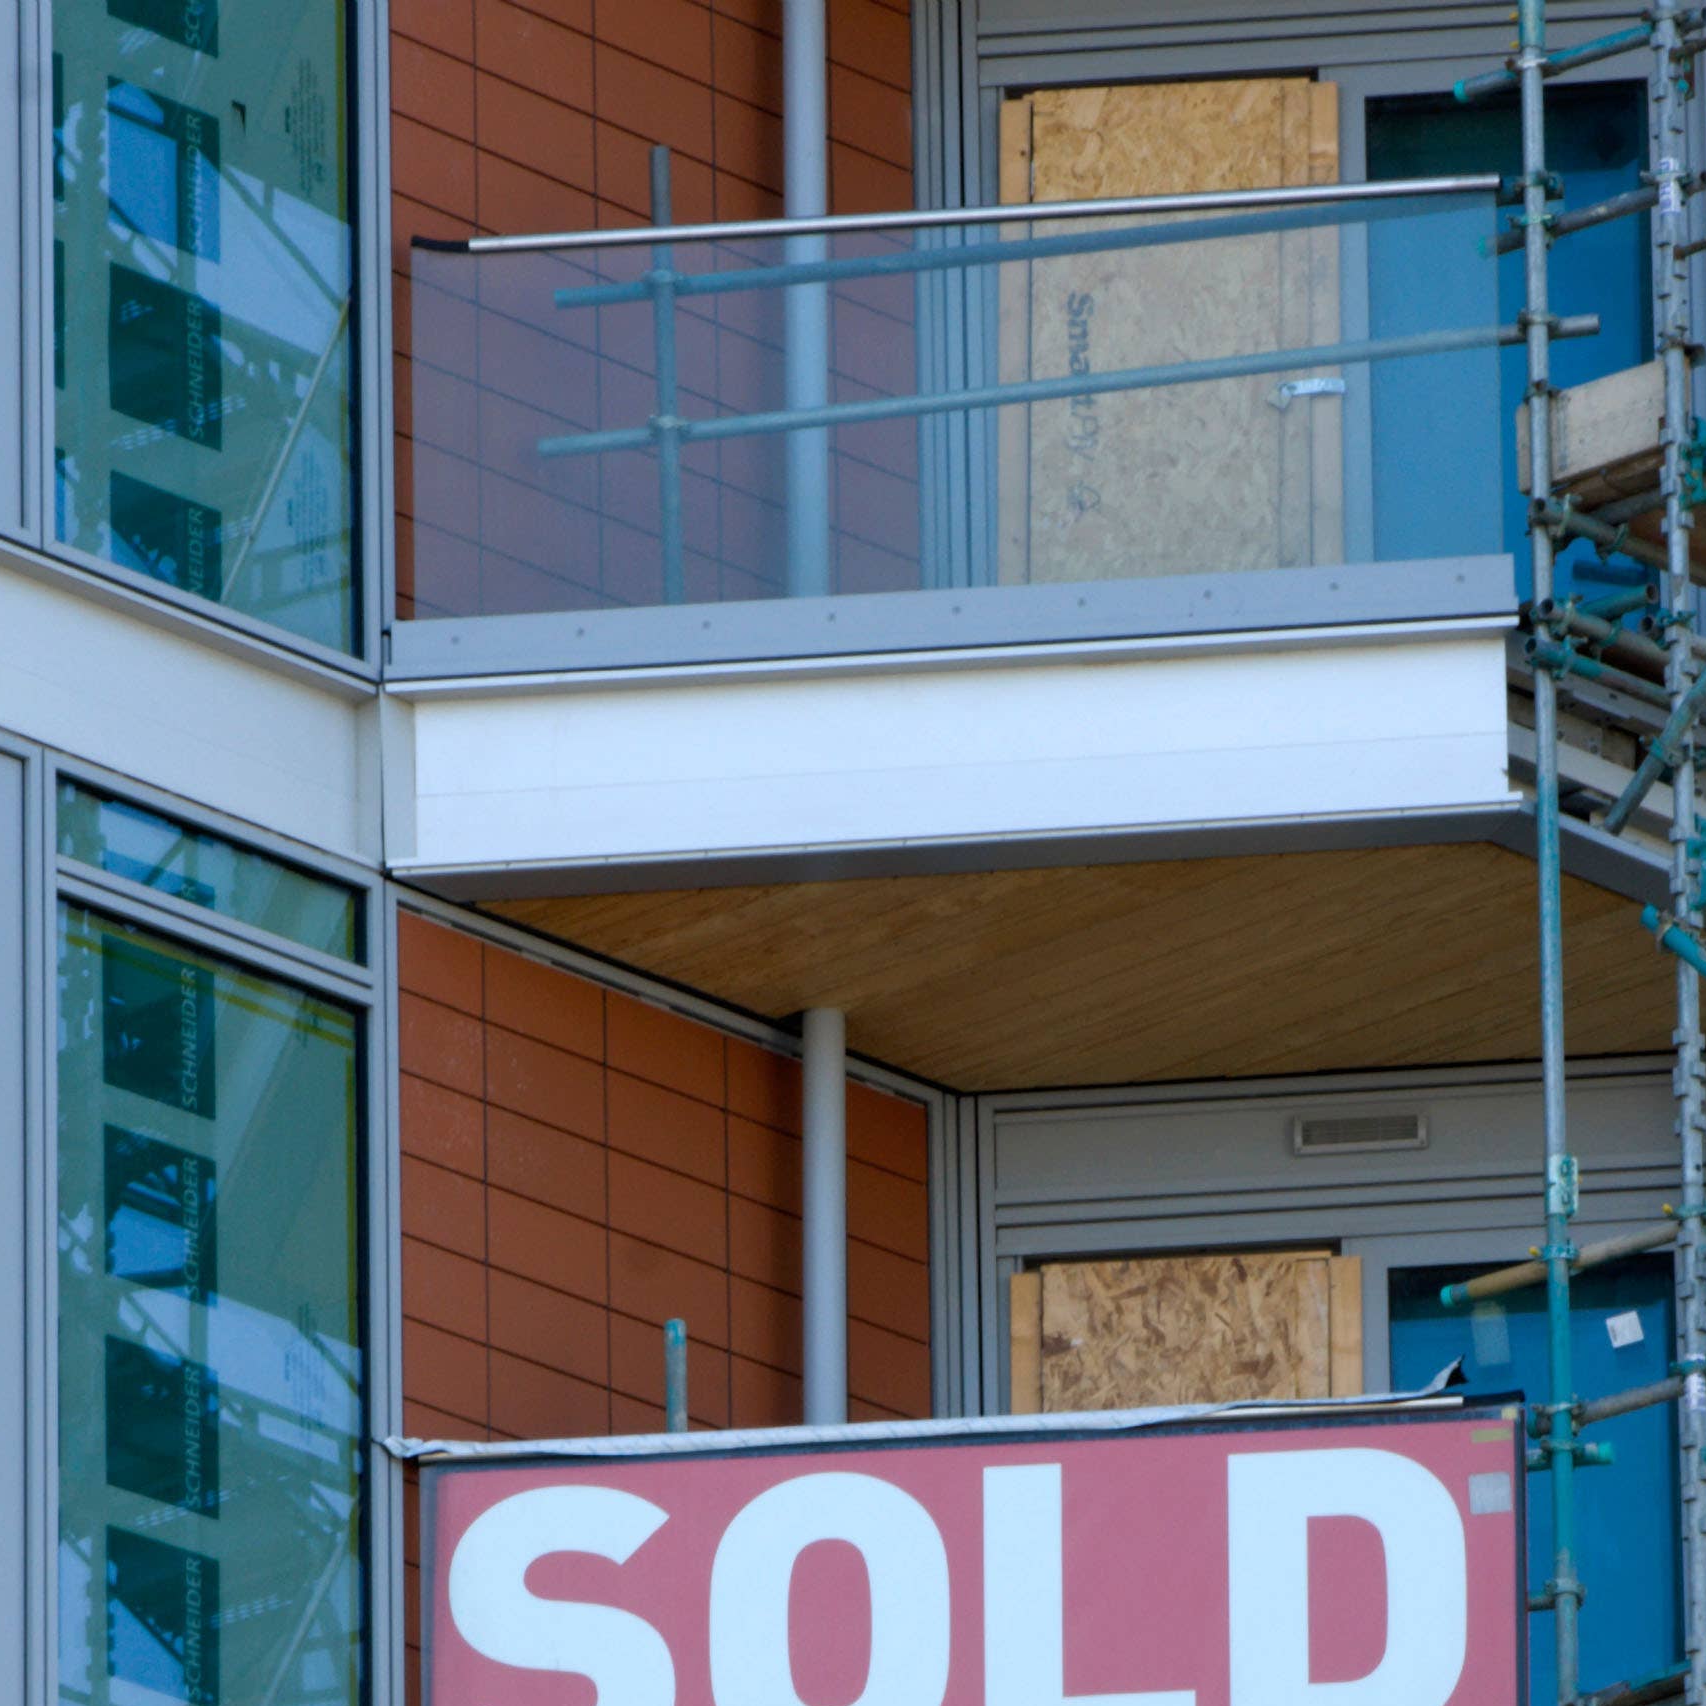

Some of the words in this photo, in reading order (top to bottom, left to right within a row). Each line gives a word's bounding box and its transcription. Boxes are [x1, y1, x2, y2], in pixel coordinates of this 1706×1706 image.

[186, 296, 205, 442] SCHNEIDER
[180, 964, 200, 1111] SCHNEIDER
[184, 1363, 204, 1511] SCHNEIDER
